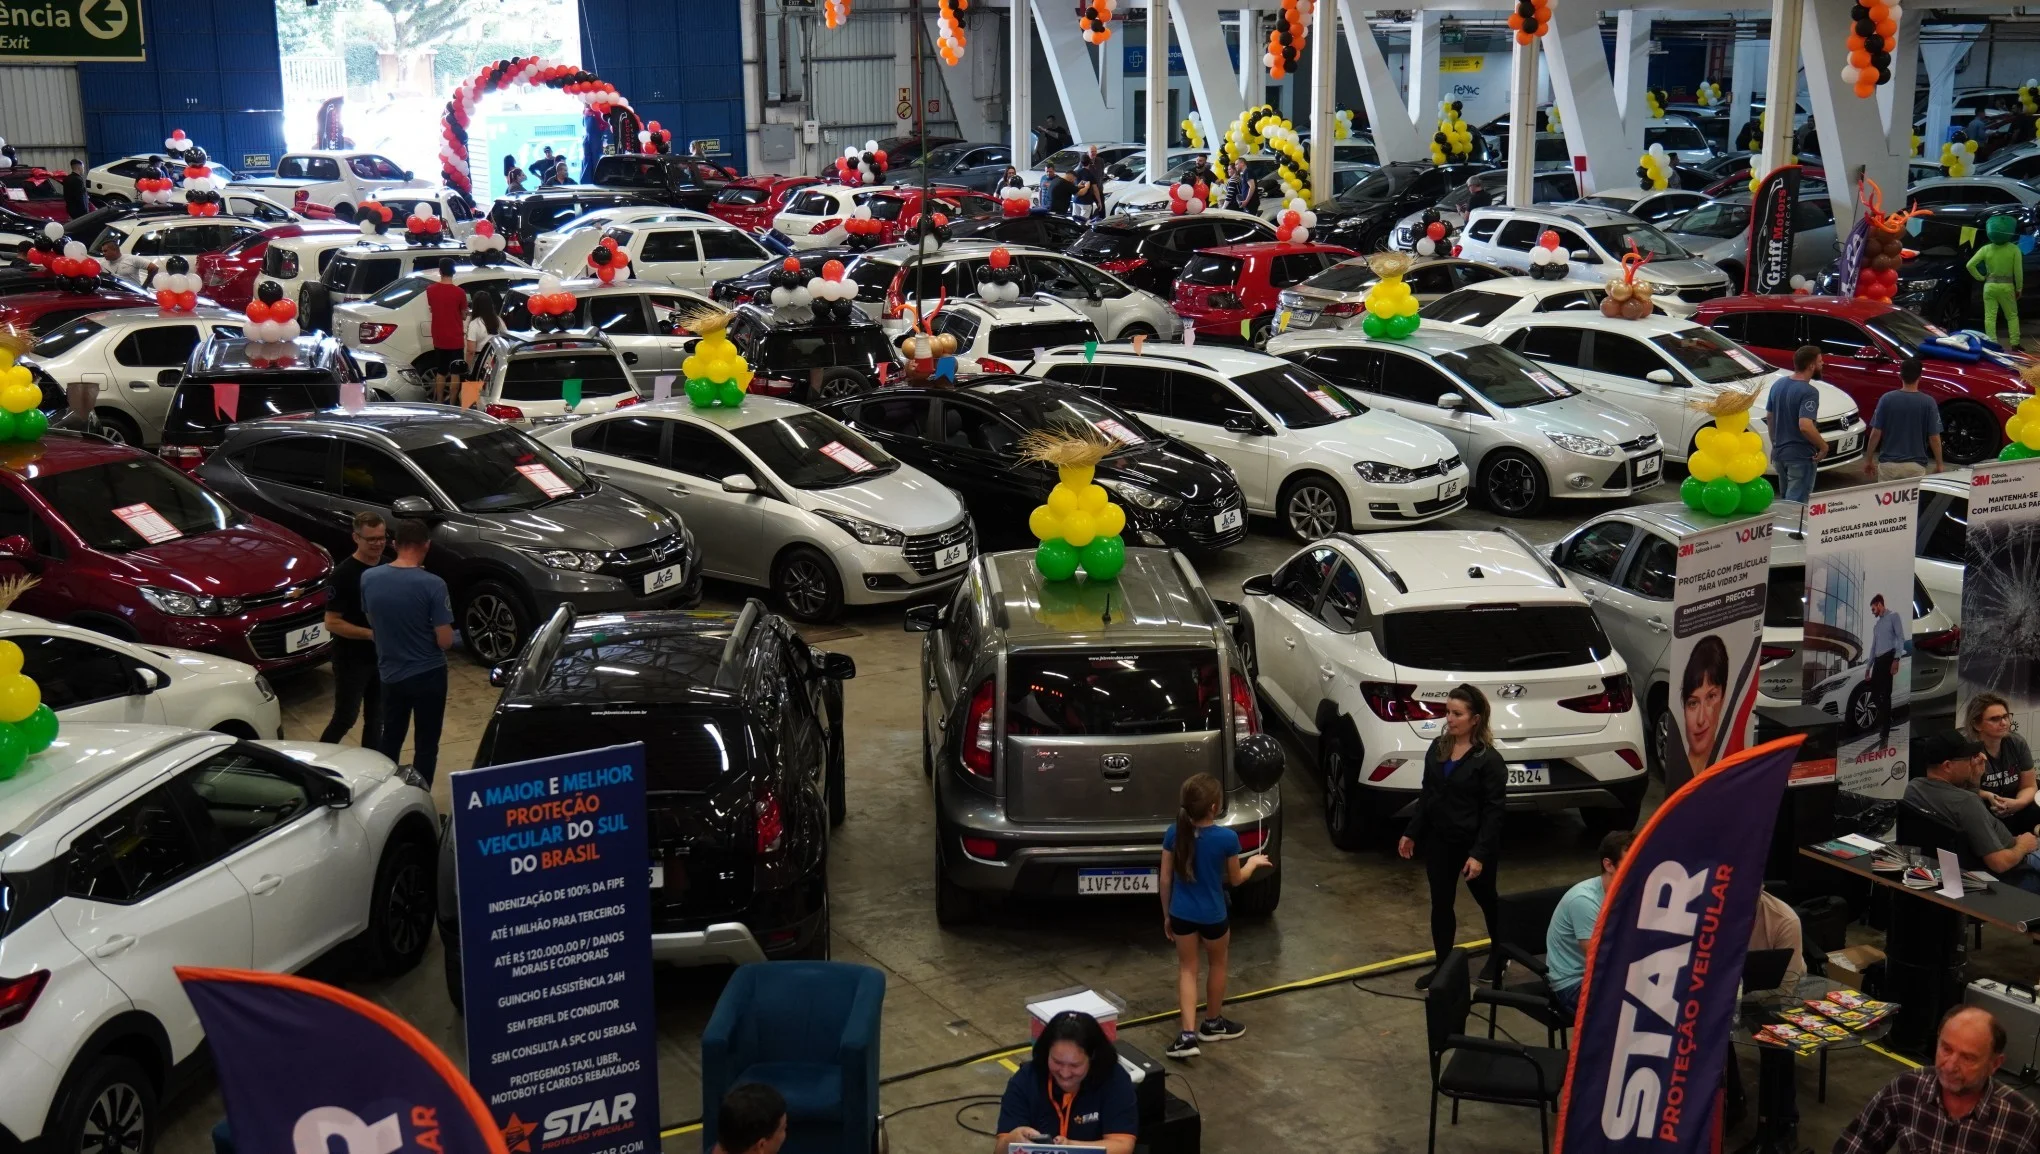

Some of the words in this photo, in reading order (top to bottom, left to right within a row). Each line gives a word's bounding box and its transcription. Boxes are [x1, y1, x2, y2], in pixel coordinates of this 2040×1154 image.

[1772, 189, 1788, 240] Motors
[1766, 239, 1783, 286] Griff
[1875, 487, 1919, 507] VOUKE
[1972, 474, 1990, 487] 3M
[1988, 491, 2039, 504] MANTENHA-SE
[1809, 503, 1827, 517] 3M
[1971, 507, 1989, 515] COM
[1990, 501, 2027, 513] PELÍCULAS
[1735, 522, 1773, 544] VOUKE
[1820, 535, 1833, 545] SÃO
[1833, 530, 1864, 543] GARANTIA
[1864, 528, 1873, 536] DE
[1873, 523, 1908, 536] QUALIDADE
[1821, 528, 1829, 536] AS
[1829, 523, 1861, 535] PELÍCULAS
[1861, 520, 1878, 529] PARA
[1878, 517, 1898, 526] VIDRO
[1897, 515, 1907, 523] 3M
[1678, 543, 1694, 558] 3M
[1678, 569, 1716, 587] PROTEÇÃO
[1716, 566, 1732, 576] COM
[1732, 555, 1768, 572] PELÍCULAS
[1698, 581, 1716, 593] PARA
[1717, 575, 1738, 588] VIDRO
[1738, 571, 1748, 581] 3M
[1683, 598, 1722, 615] ENVELHECIMENTO
[1725, 588, 1755, 604] PRECOCE
[1855, 747, 1897, 765] ATENTO
[468, 791, 483, 810] A
[486, 780, 545, 807] MAIOR
[549, 777, 559, 796] E
[563, 764, 634, 793] MELHOR
[506, 792, 601, 828] PROTEÇÃO
[478, 825, 564, 856] VEICULAR
[567, 819, 594, 840] DO
[597, 813, 629, 835] SUL
[510, 854, 538, 876] DO
[541, 842, 601, 870] BRASIL
[488, 890, 553, 914] INDENIZAÇÃO
[554, 888, 566, 900] DE
[566, 883, 592, 898] 100%
[592, 881, 606, 893] DA
[606, 876, 626, 890] FIPE
[1087, 876, 1150, 892] IVF7C64
[491, 926, 508, 941] ATÉ
[509, 926, 514, 937] 1
[514, 917, 551, 936] MILHÃO
[552, 913, 577, 928] PARA
[577, 904, 626, 923] TERCEIROS
[494, 952, 512, 968] ATÉ
[512, 951, 526, 964] R$
[526, 941, 579, 960] 120.000,00
[579, 937, 592, 950] P/
[592, 930, 625, 947] DANOS
[512, 960, 549, 978] MORAIS
[550, 959, 556, 970] E
[556, 947, 610, 968] CORPORAIS
[498, 989, 541, 1008] GUINCHO
[542, 987, 549, 998] E
[549, 976, 606, 997] ASSISTÊNCIA
[607, 970, 626, 984] 24H
[1601, 860, 1709, 1141] STAR
[1659, 999, 1701, 1143] PROTEÇÃO
[1688, 863, 1734, 993] VEICULAR
[507, 1019, 526, 1034] SEM
[527, 1012, 556, 1029] PERFIL
[557, 1010, 569, 1022] DE
[569, 999, 620, 1019] CONDUTOR
[491, 1050, 511, 1065] SEM
[511, 1039, 560, 1060] CONSULTA
[560, 1037, 569, 1049] A
[569, 1031, 587, 1046] SPC
[588, 1029, 602, 1042] OU
[603, 1021, 638, 1039] SERASA
[491, 1085, 538, 1105] MOTOBOY
[539, 1082, 545, 1093] E
[546, 1074, 584, 1093] CARROS
[585, 1060, 641, 1083] REBAIXADOS
[510, 1062, 571, 1087] PROTEGEMOS
[571, 1058, 595, 1073] TAXI,
[596, 1052, 622, 1066] UBER,
[542, 1092, 637, 1141] STAR
[541, 1131, 590, 1151] PROTEÇÃO
[592, 1120, 636, 1138] VEICULAR
